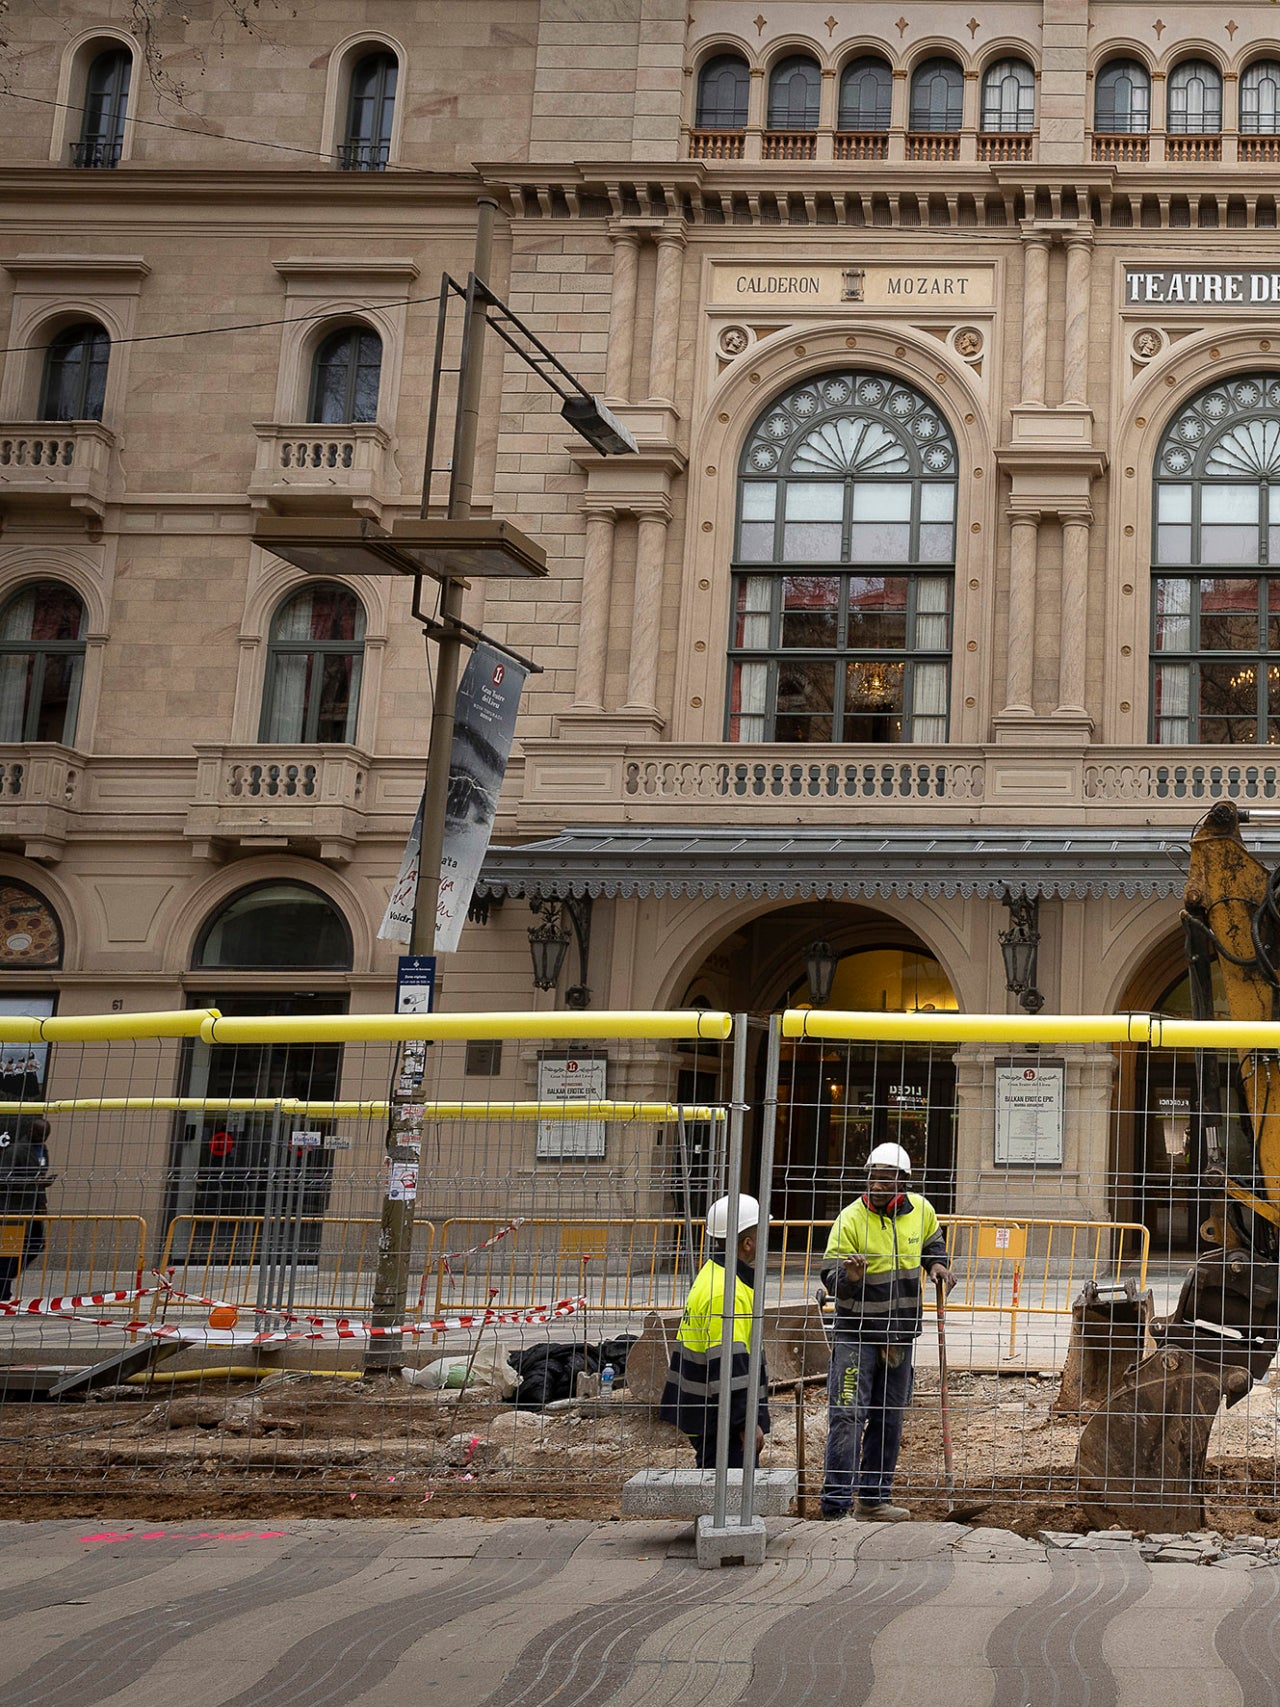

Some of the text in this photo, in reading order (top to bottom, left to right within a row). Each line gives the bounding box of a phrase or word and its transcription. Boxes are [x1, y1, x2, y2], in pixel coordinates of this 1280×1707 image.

[736, 276, 820, 293] CALDERON
[888, 277, 969, 295] MOZART
[1127, 273, 1243, 302] TEATRE
[112, 999, 124, 1011] 61
[1042, 1095, 1054, 1103] EPIC
